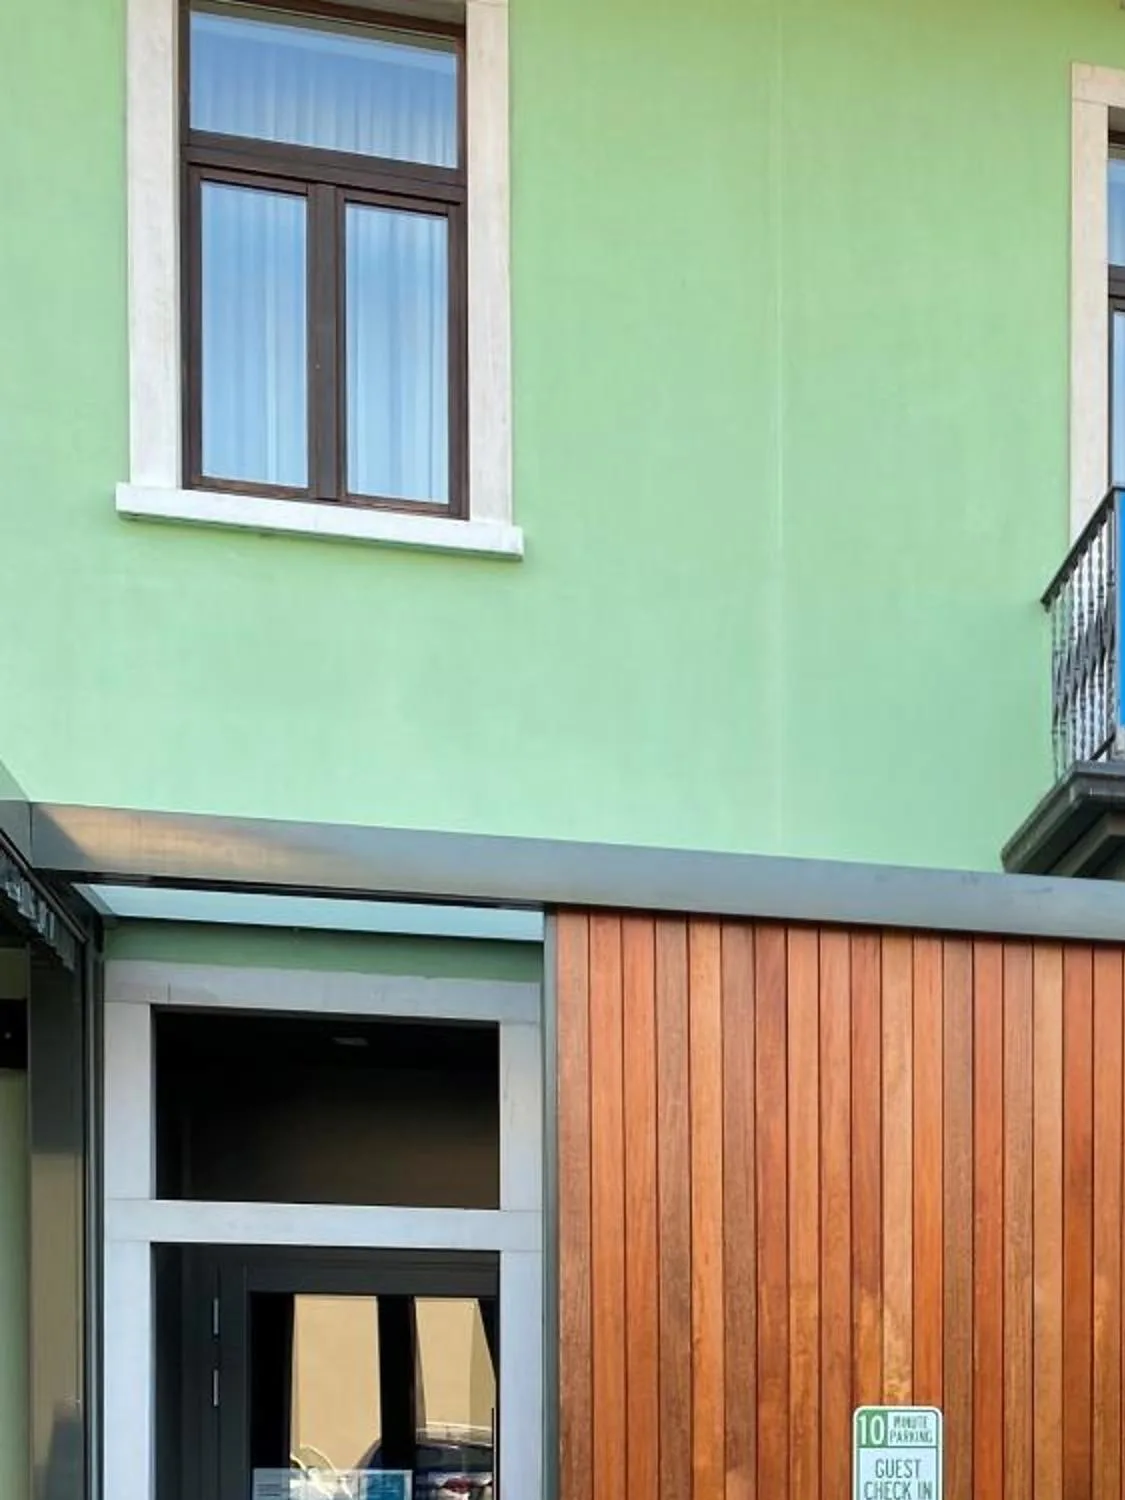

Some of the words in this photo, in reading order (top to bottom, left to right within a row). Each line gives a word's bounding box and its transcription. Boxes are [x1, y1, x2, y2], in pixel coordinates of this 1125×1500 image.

[858, 1414, 885, 1445] 10
[893, 1415, 928, 1429] MINUTE
[889, 1430, 933, 1443] PARKING
[875, 1458, 922, 1479] GUEST
[864, 1481, 912, 1500] CHECK
[917, 1481, 933, 1500] IN
